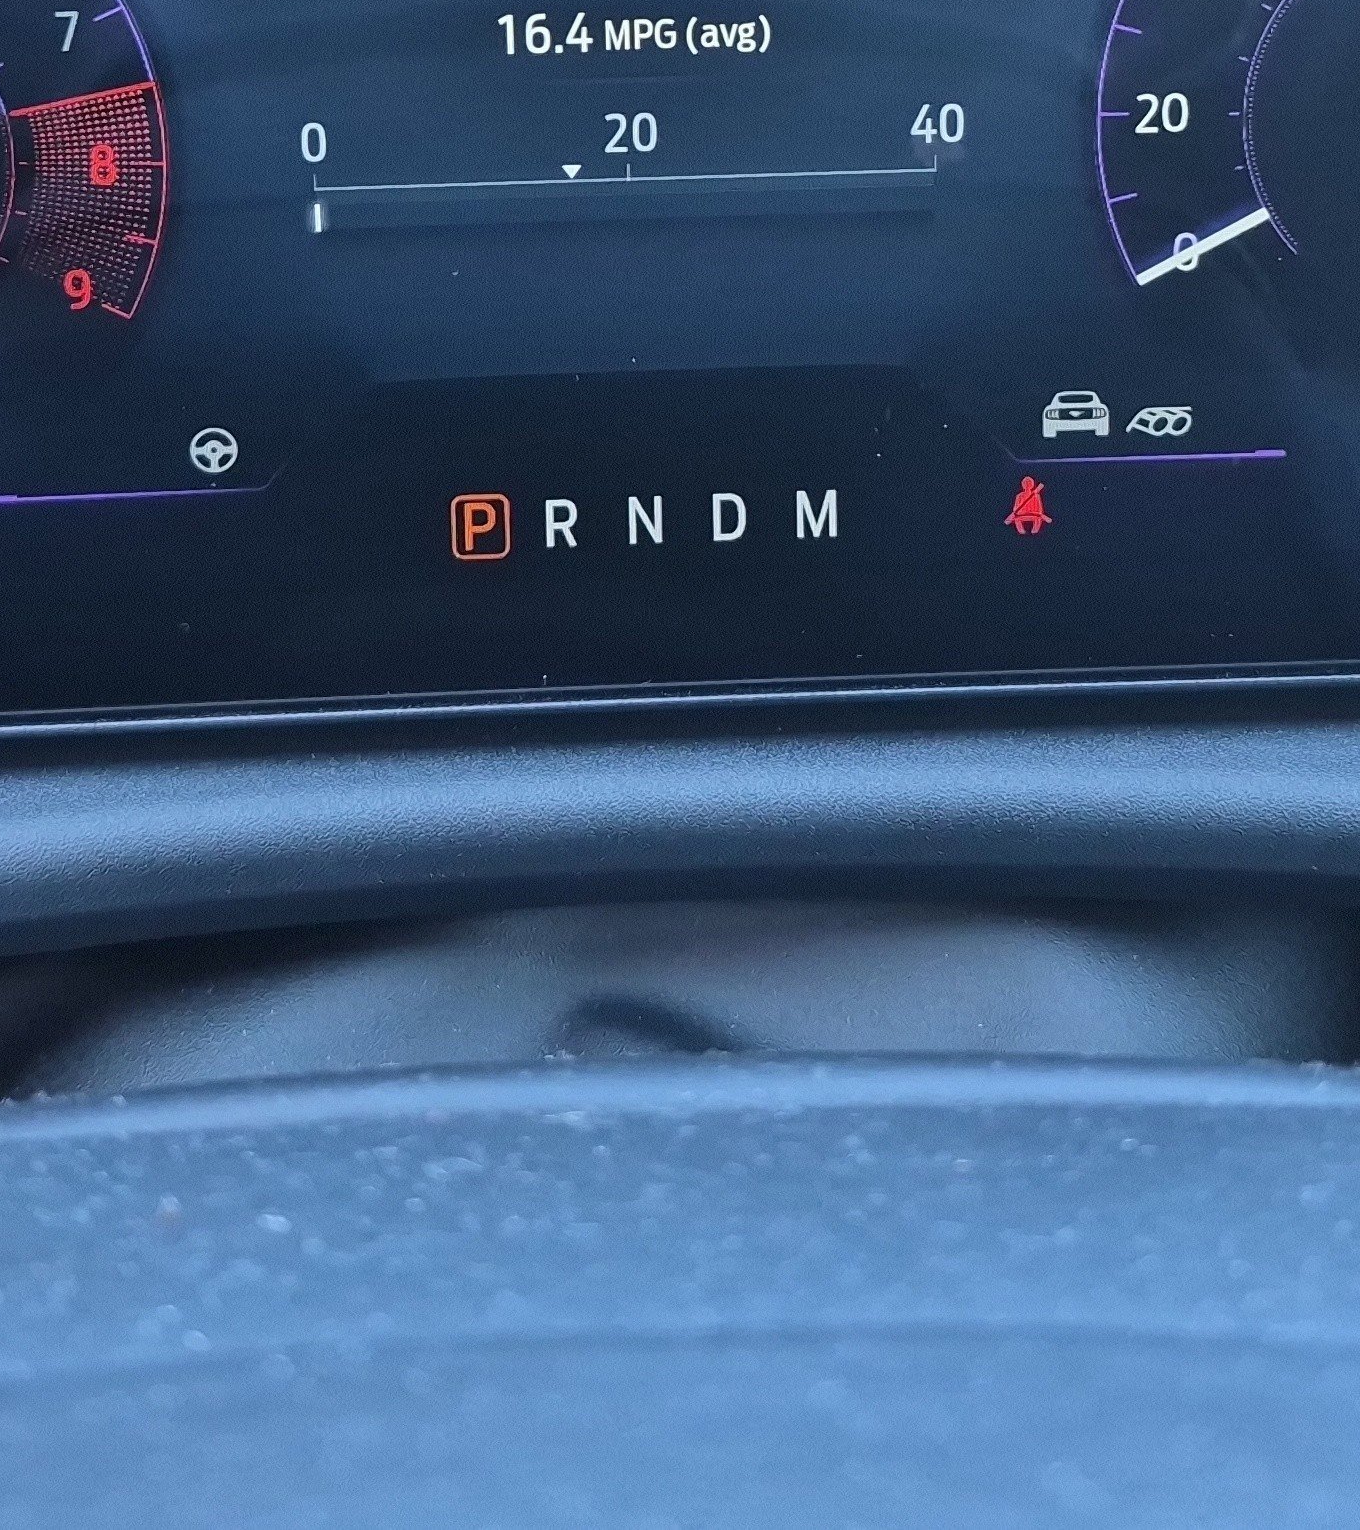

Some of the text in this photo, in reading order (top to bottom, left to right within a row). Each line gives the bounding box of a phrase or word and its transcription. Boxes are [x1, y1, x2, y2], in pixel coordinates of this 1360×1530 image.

[54, 10, 79, 52] 7
[497, 12, 771, 55] 16.4 MPG (avg)
[300, 103, 965, 163] 0 20 40
[1134, 92, 1189, 134] 20
[90, 143, 118, 186] 8
[63, 268, 92, 311] 9
[464, 489, 838, 551] P R N D M
